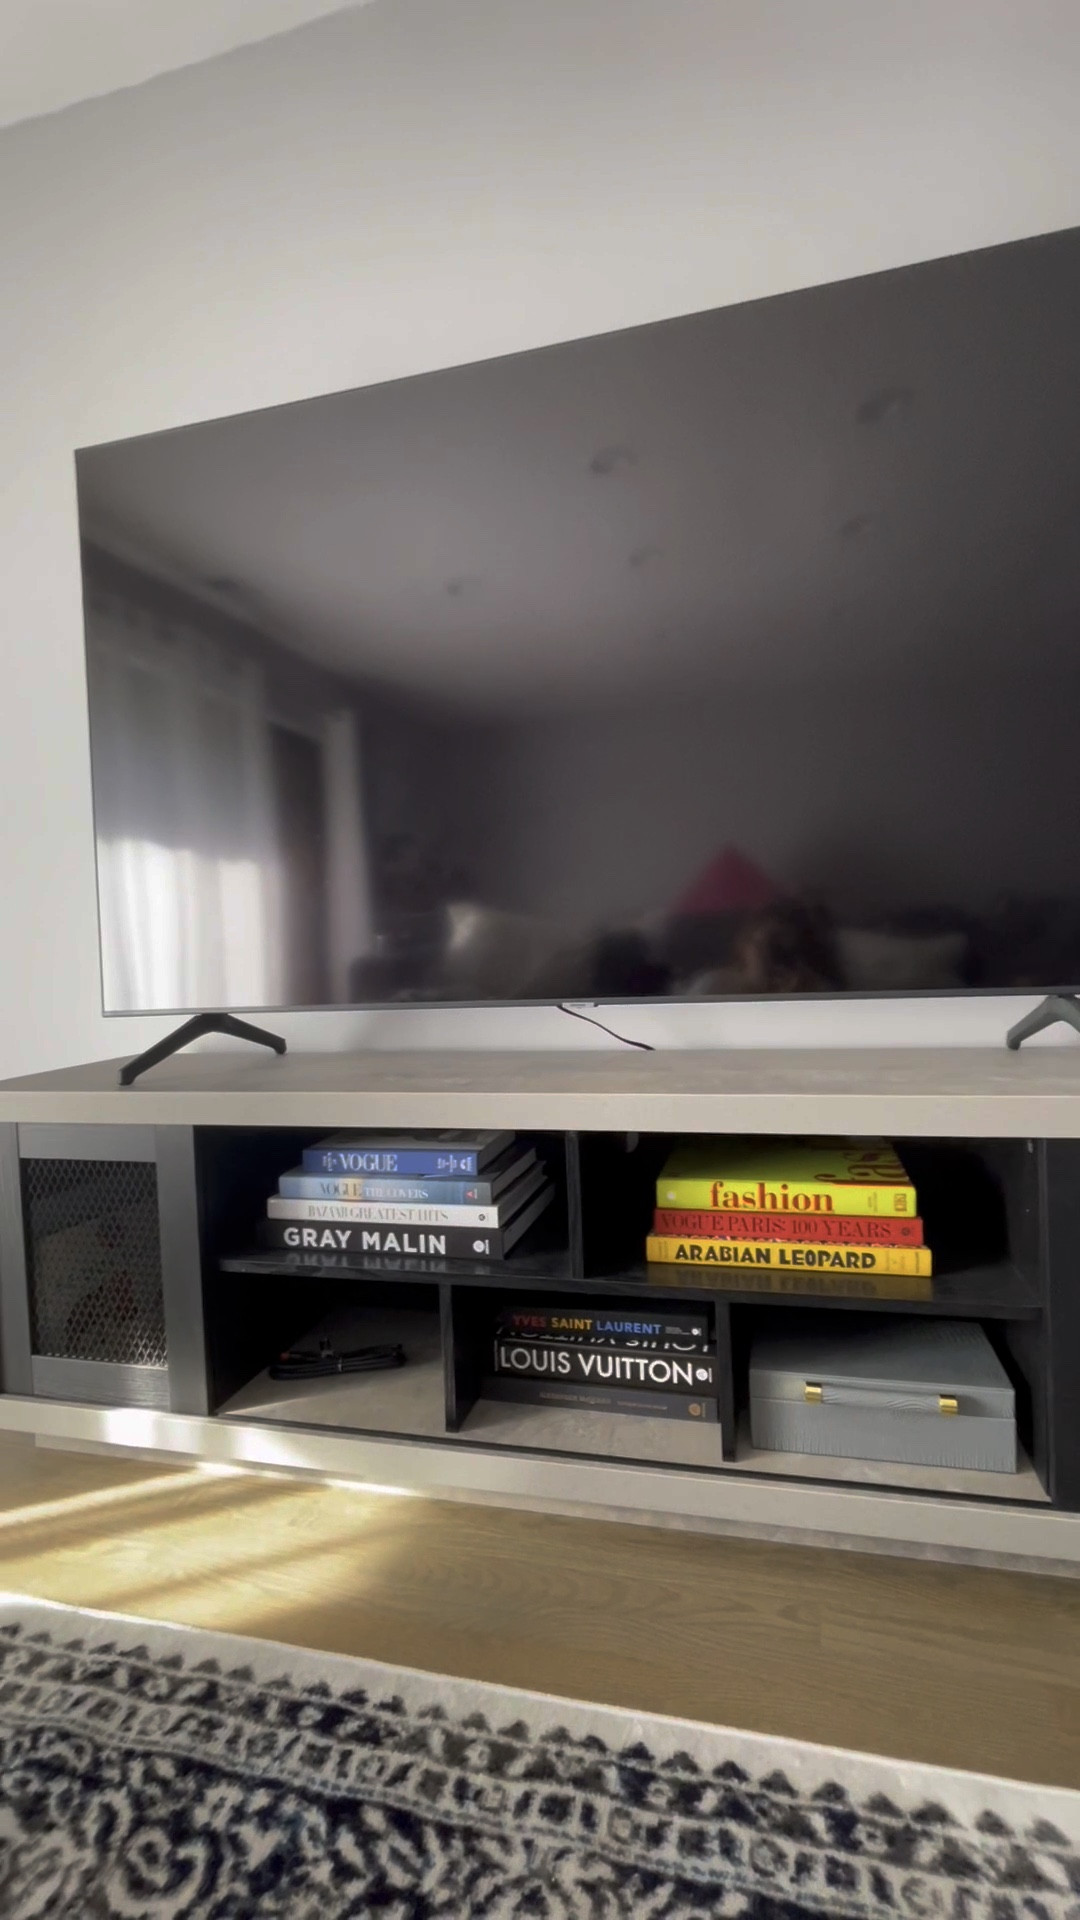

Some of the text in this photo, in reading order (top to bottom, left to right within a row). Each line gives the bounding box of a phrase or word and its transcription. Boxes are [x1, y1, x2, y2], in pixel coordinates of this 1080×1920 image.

[339, 1153, 398, 1172] VOGUE
[320, 1182, 430, 1200] VOGUE THE COVERS
[710, 1181, 833, 1212] fashion
[351, 1207, 414, 1220] GREATEST
[418, 1209, 449, 1221] HITS
[660, 1215, 891, 1238] VOGUE PARIS 100 YEARS
[283, 1227, 446, 1255] GRAY MALIN
[674, 1244, 771, 1264] ARABIAN
[779, 1248, 876, 1269] LEOPARD
[512, 1315, 546, 1328] YVES
[551, 1317, 593, 1331] SAINT
[596, 1320, 662, 1335] LAURENT
[500, 1346, 571, 1374] LOUIS
[577, 1353, 693, 1386] VUITTON
